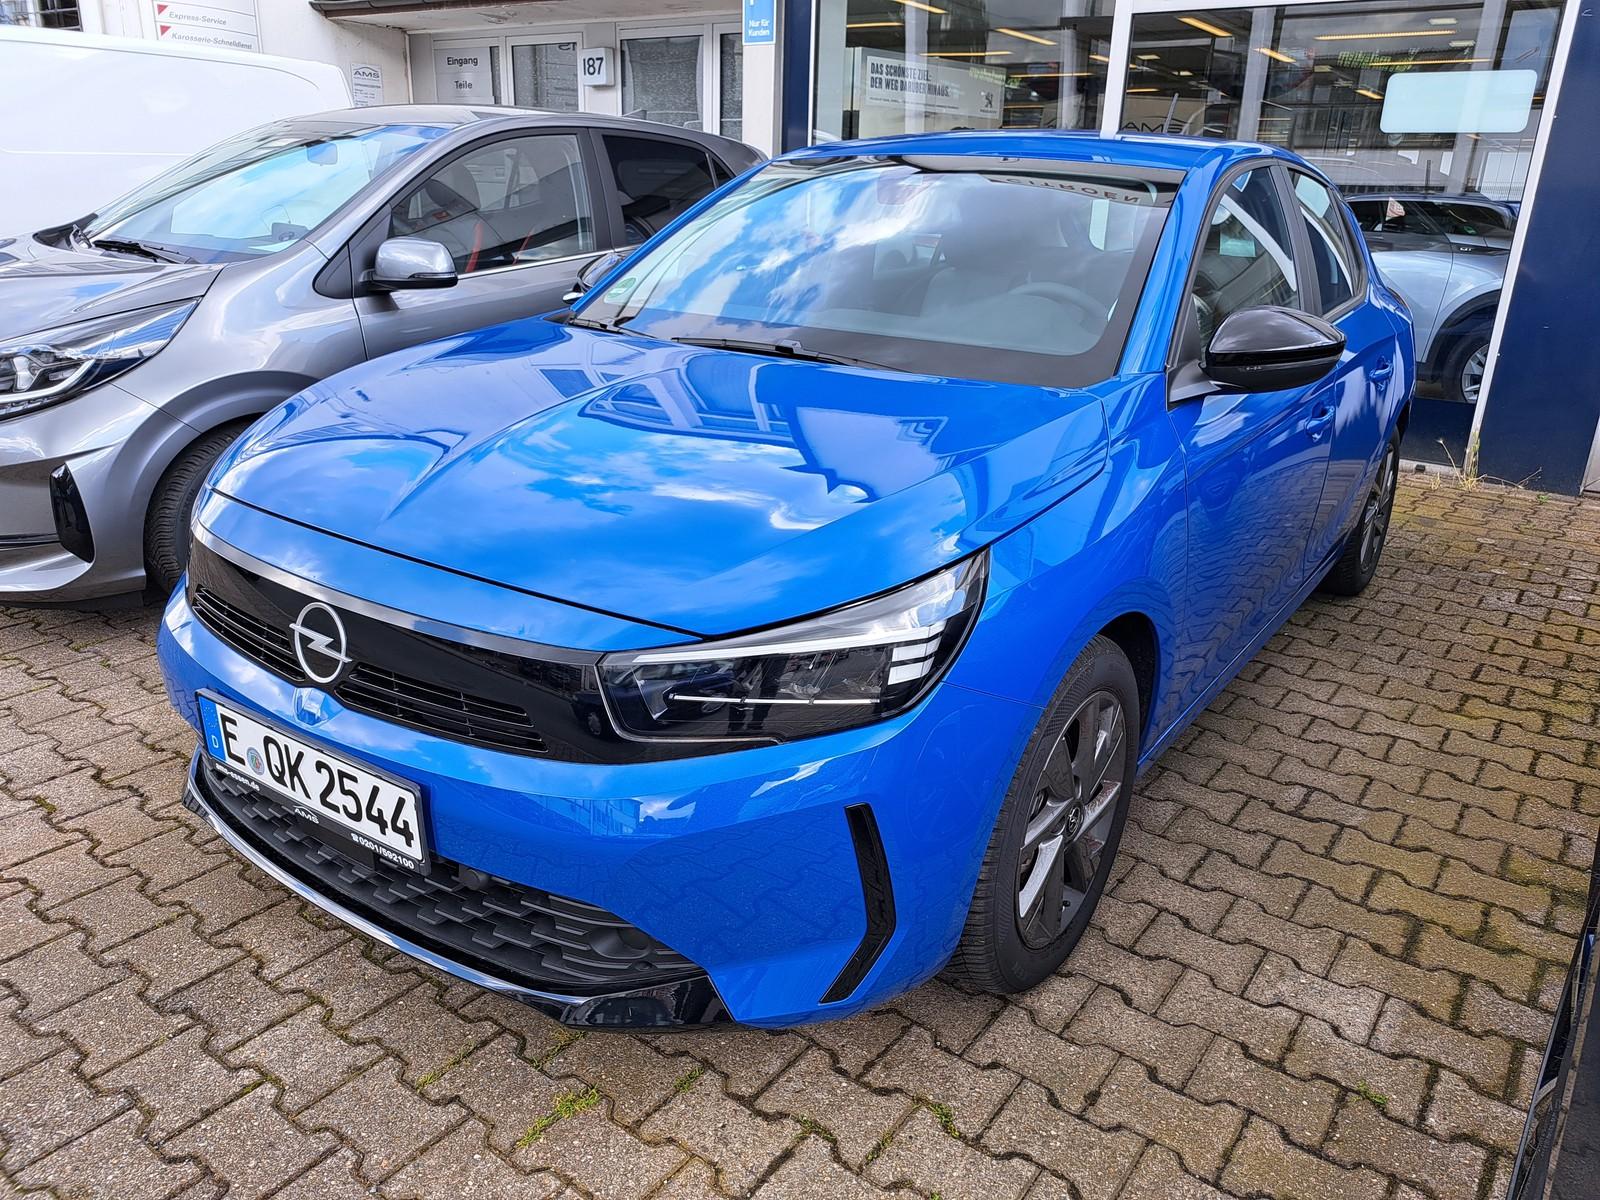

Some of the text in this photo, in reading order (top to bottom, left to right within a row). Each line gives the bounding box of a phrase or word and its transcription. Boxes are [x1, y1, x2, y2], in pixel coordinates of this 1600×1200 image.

[169, 11, 227, 25] Express-Service
[748, 27, 770, 37] Kunden
[172, 33, 252, 50] Karosserie-Schnelldienst
[447, 56, 478, 67] Eingang
[583, 57, 604, 76] 187
[870, 62, 884, 75] DAS
[353, 70, 380, 78] AMS
[454, 80, 473, 89] Teile
[870, 76, 883, 89] DER
[885, 78, 899, 91] WEG
[1122, 121, 1183, 134] AMS
[211, 734, 219, 749] D
[220, 713, 415, 848] E QK 2544
[293, 807, 320, 824] AMS
